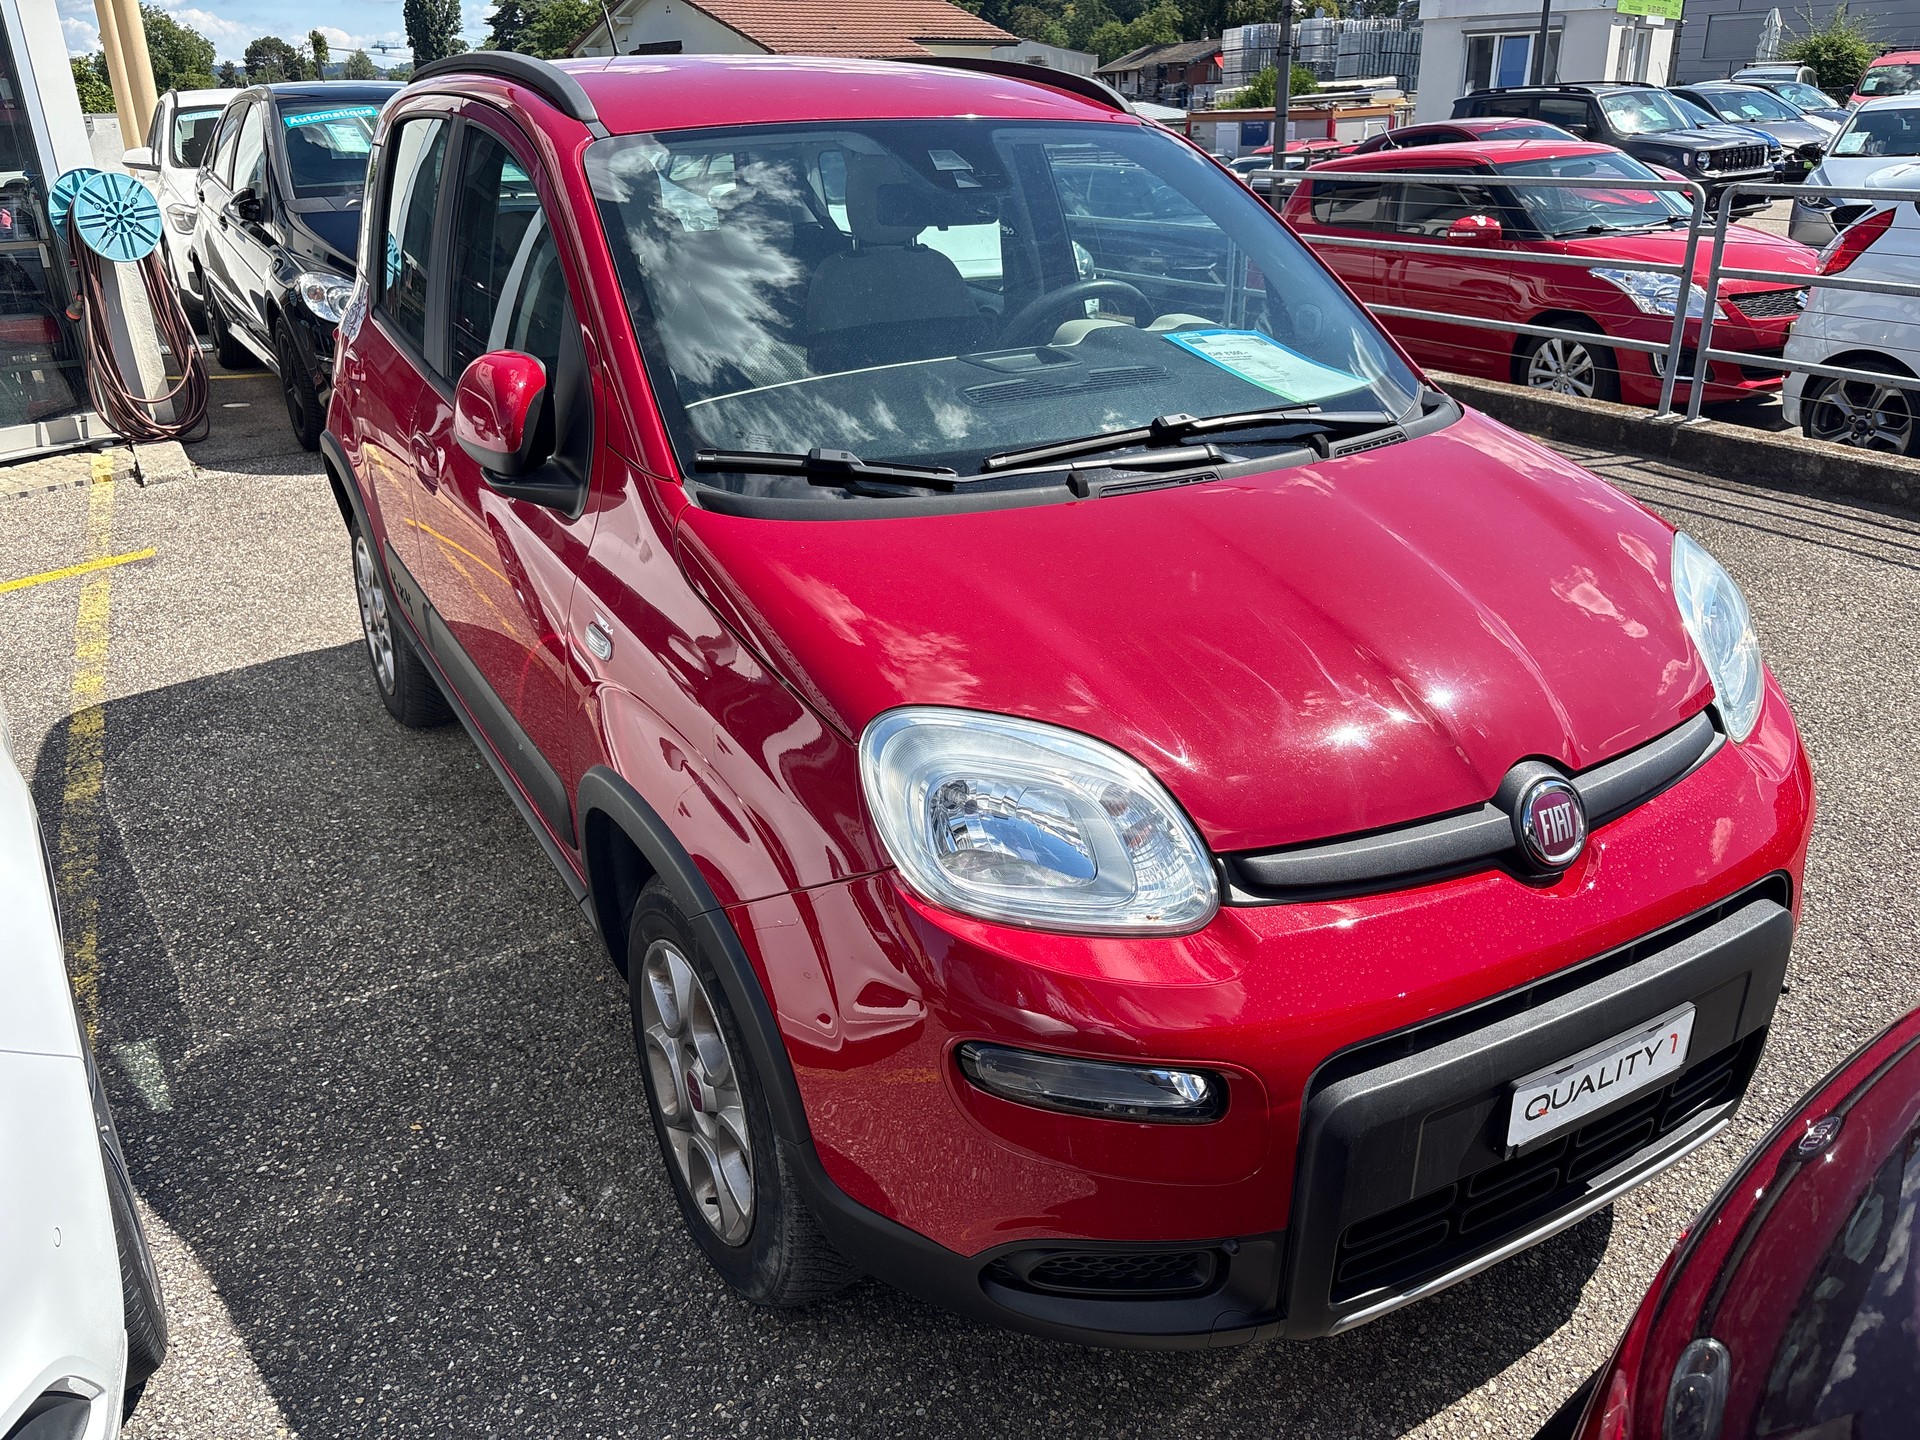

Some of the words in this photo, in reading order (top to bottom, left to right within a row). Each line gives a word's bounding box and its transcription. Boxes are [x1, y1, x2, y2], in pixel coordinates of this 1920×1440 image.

[289, 108, 374, 125] Automatique
[1538, 801, 1574, 846] FIAT
[1524, 1039, 1664, 1121] QUALITY
[1669, 1032, 1679, 1055] 1
